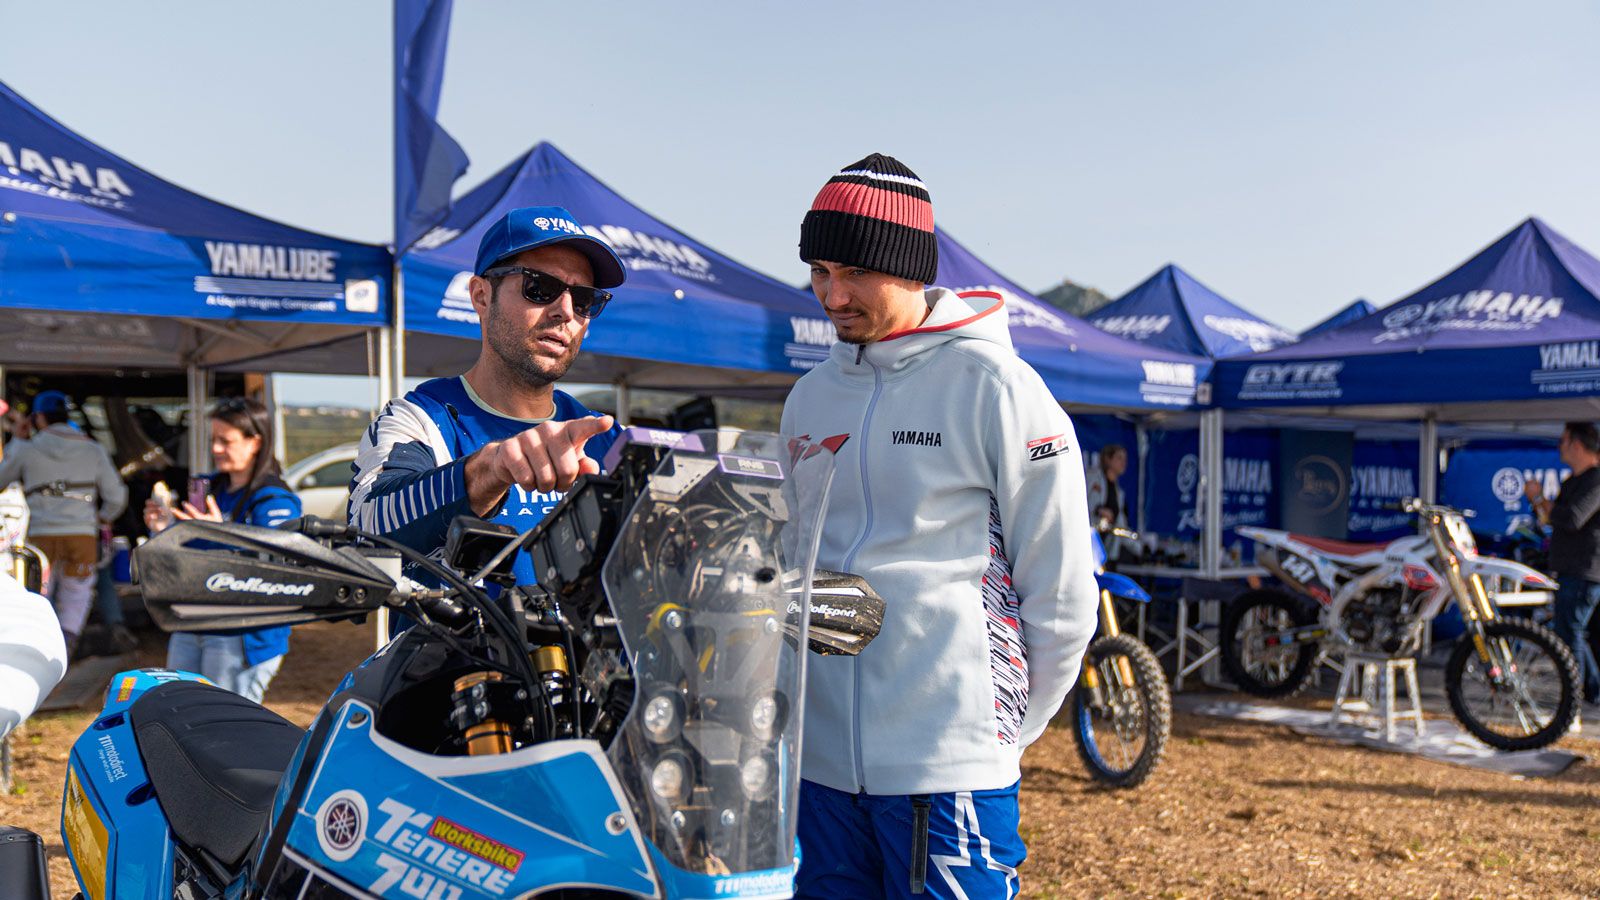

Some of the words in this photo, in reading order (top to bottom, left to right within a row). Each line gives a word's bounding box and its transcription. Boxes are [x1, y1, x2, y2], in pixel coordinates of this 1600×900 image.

[205, 241, 337, 282] YAMALUBE
[1243, 361, 1344, 384] GYTR
[892, 430, 942, 447] YAMAHA
[206, 572, 315, 597] Polisport
